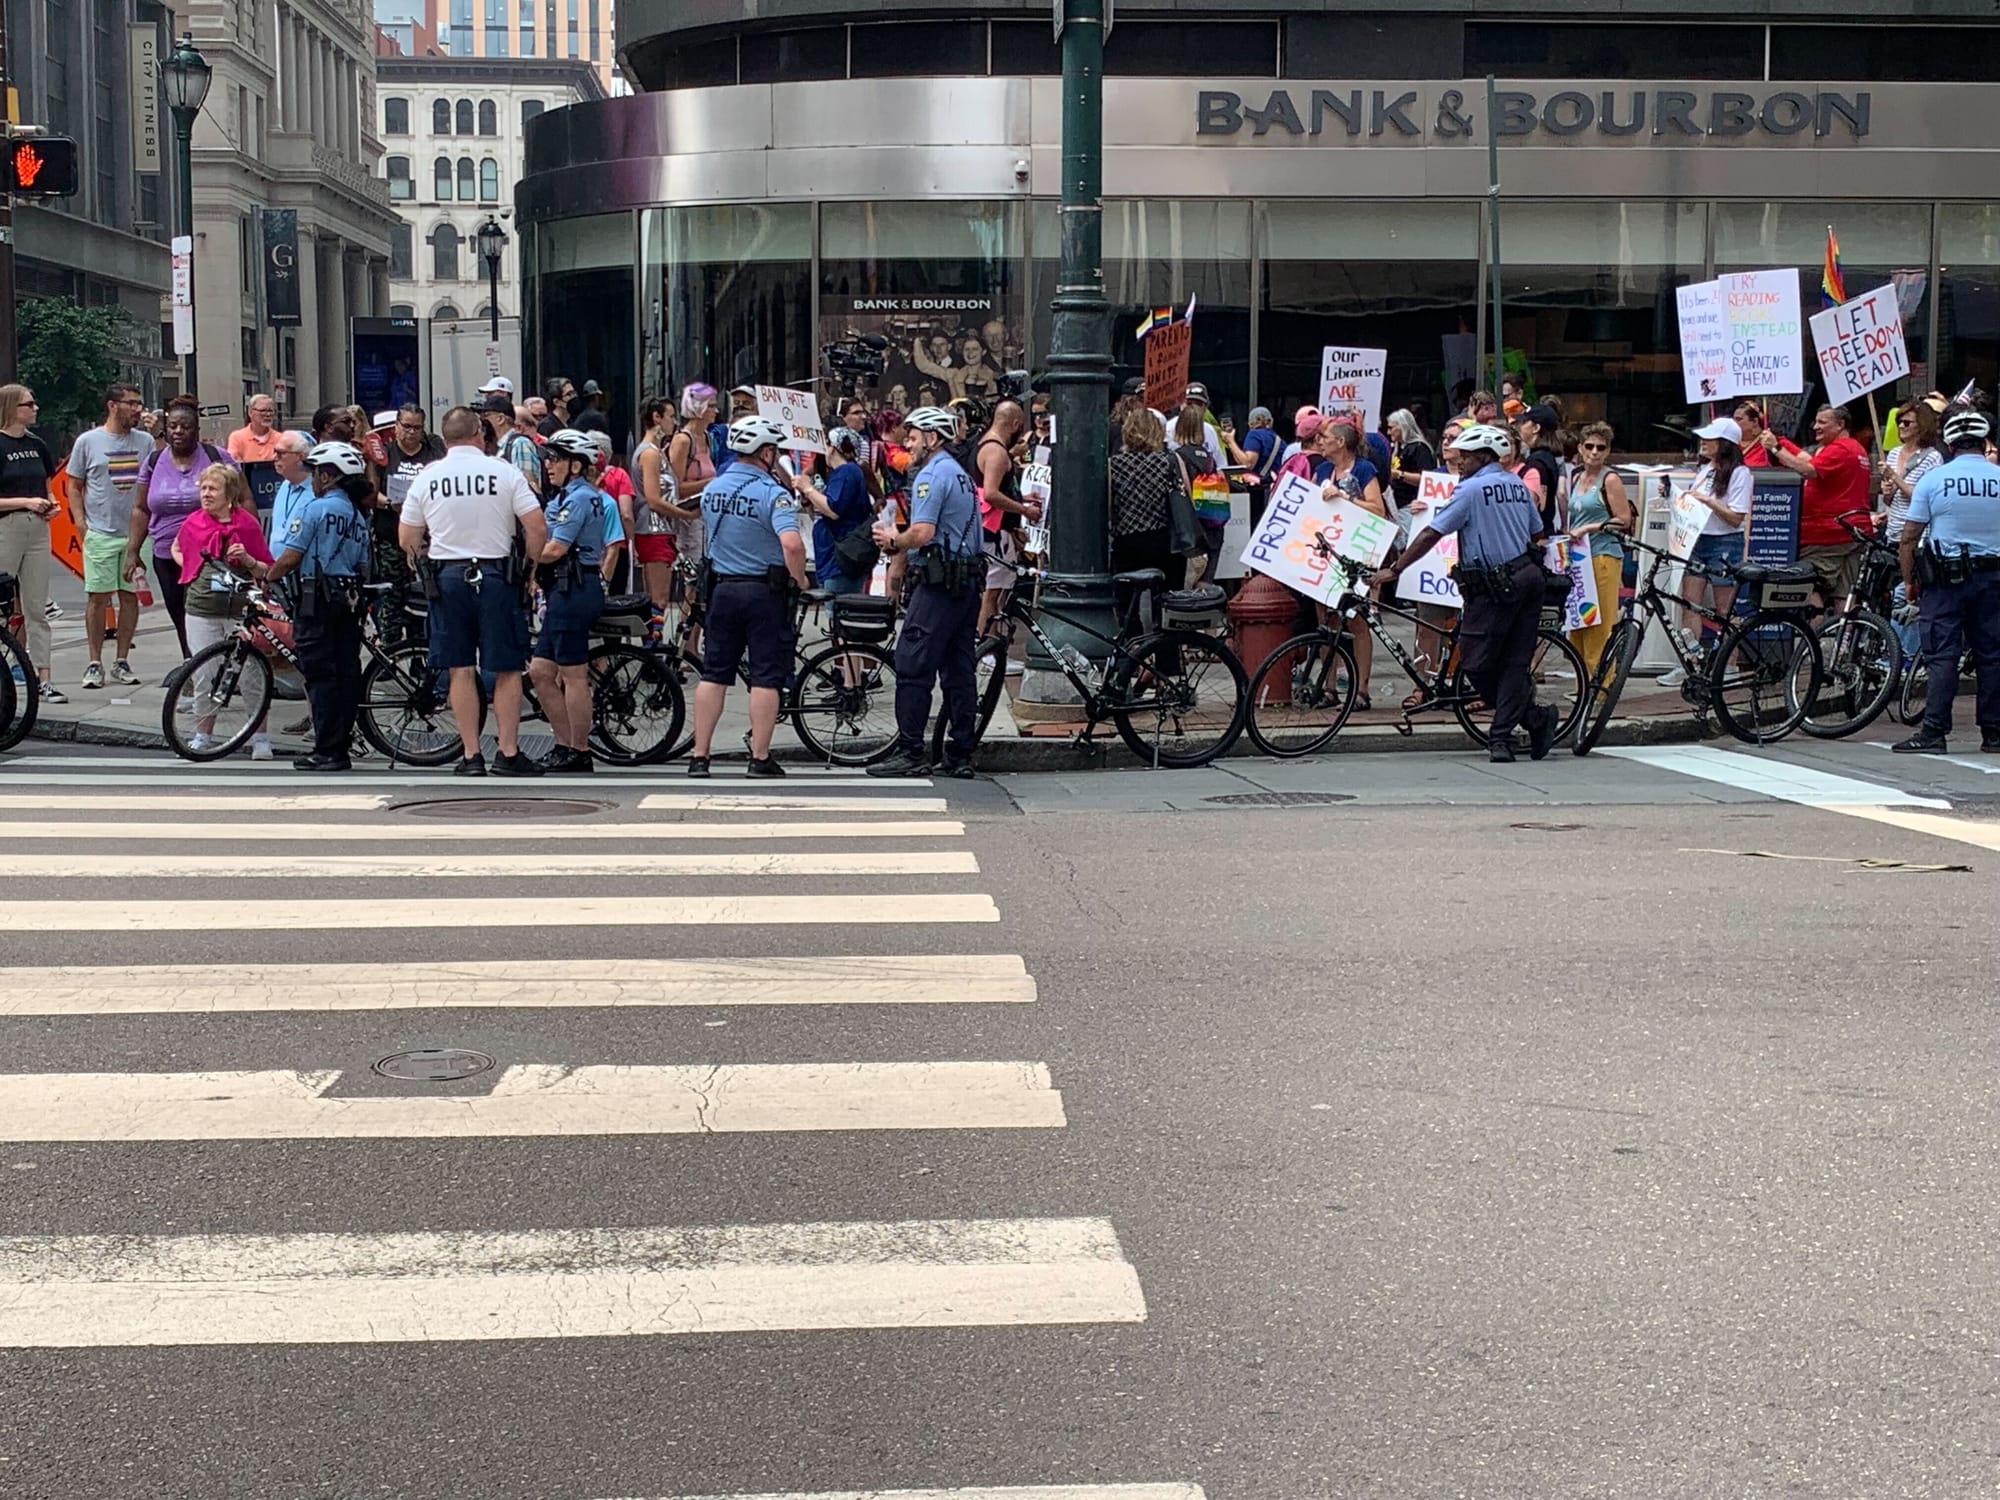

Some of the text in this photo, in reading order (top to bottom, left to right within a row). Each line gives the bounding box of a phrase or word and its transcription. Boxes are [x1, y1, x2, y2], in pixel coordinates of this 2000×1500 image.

[143, 40, 156, 157] CITY FITNESS
[1196, 89, 1871, 137] BANK & BOURBON
[271, 243, 293, 267] G
[1730, 274, 1757, 290] TRY
[853, 299, 991, 310] BANK & BOURBON
[1727, 291, 1780, 307] READING
[1730, 321, 1798, 339] INSTEAD
[1834, 297, 1876, 340] LET
[1731, 339, 1757, 356] OF
[1820, 319, 1902, 377] FREEDOM
[1326, 363, 1382, 381] Libraries
[1732, 355, 1790, 372] BANNING
[1845, 346, 1902, 394] READ!
[1733, 371, 1777, 387] THEM!
[761, 386, 808, 409] BAN HATE
[1328, 384, 1360, 400] ARE
[258, 482, 280, 494] LOE
[430, 475, 498, 500] POLICE
[1482, 483, 1528, 506] POLICE
[1763, 493, 1792, 503] Family
[1943, 477, 2000, 498] POLIC
[703, 493, 760, 519] POLICE
[1751, 513, 1790, 522] ampions!
[1752, 503, 1791, 513] aregivers
[325, 513, 367, 544] POLIC
[1251, 476, 1310, 563] PROTECT
[1300, 513, 1343, 586] LGQ+
[1325, 513, 1386, 592] YTH
[1420, 571, 1460, 597] BOO
[1538, 619, 1556, 627] ICE
[257, 624, 298, 663] POLICE
[1030, 620, 1072, 674] TREK
[1366, 615, 1404, 665] TREK
